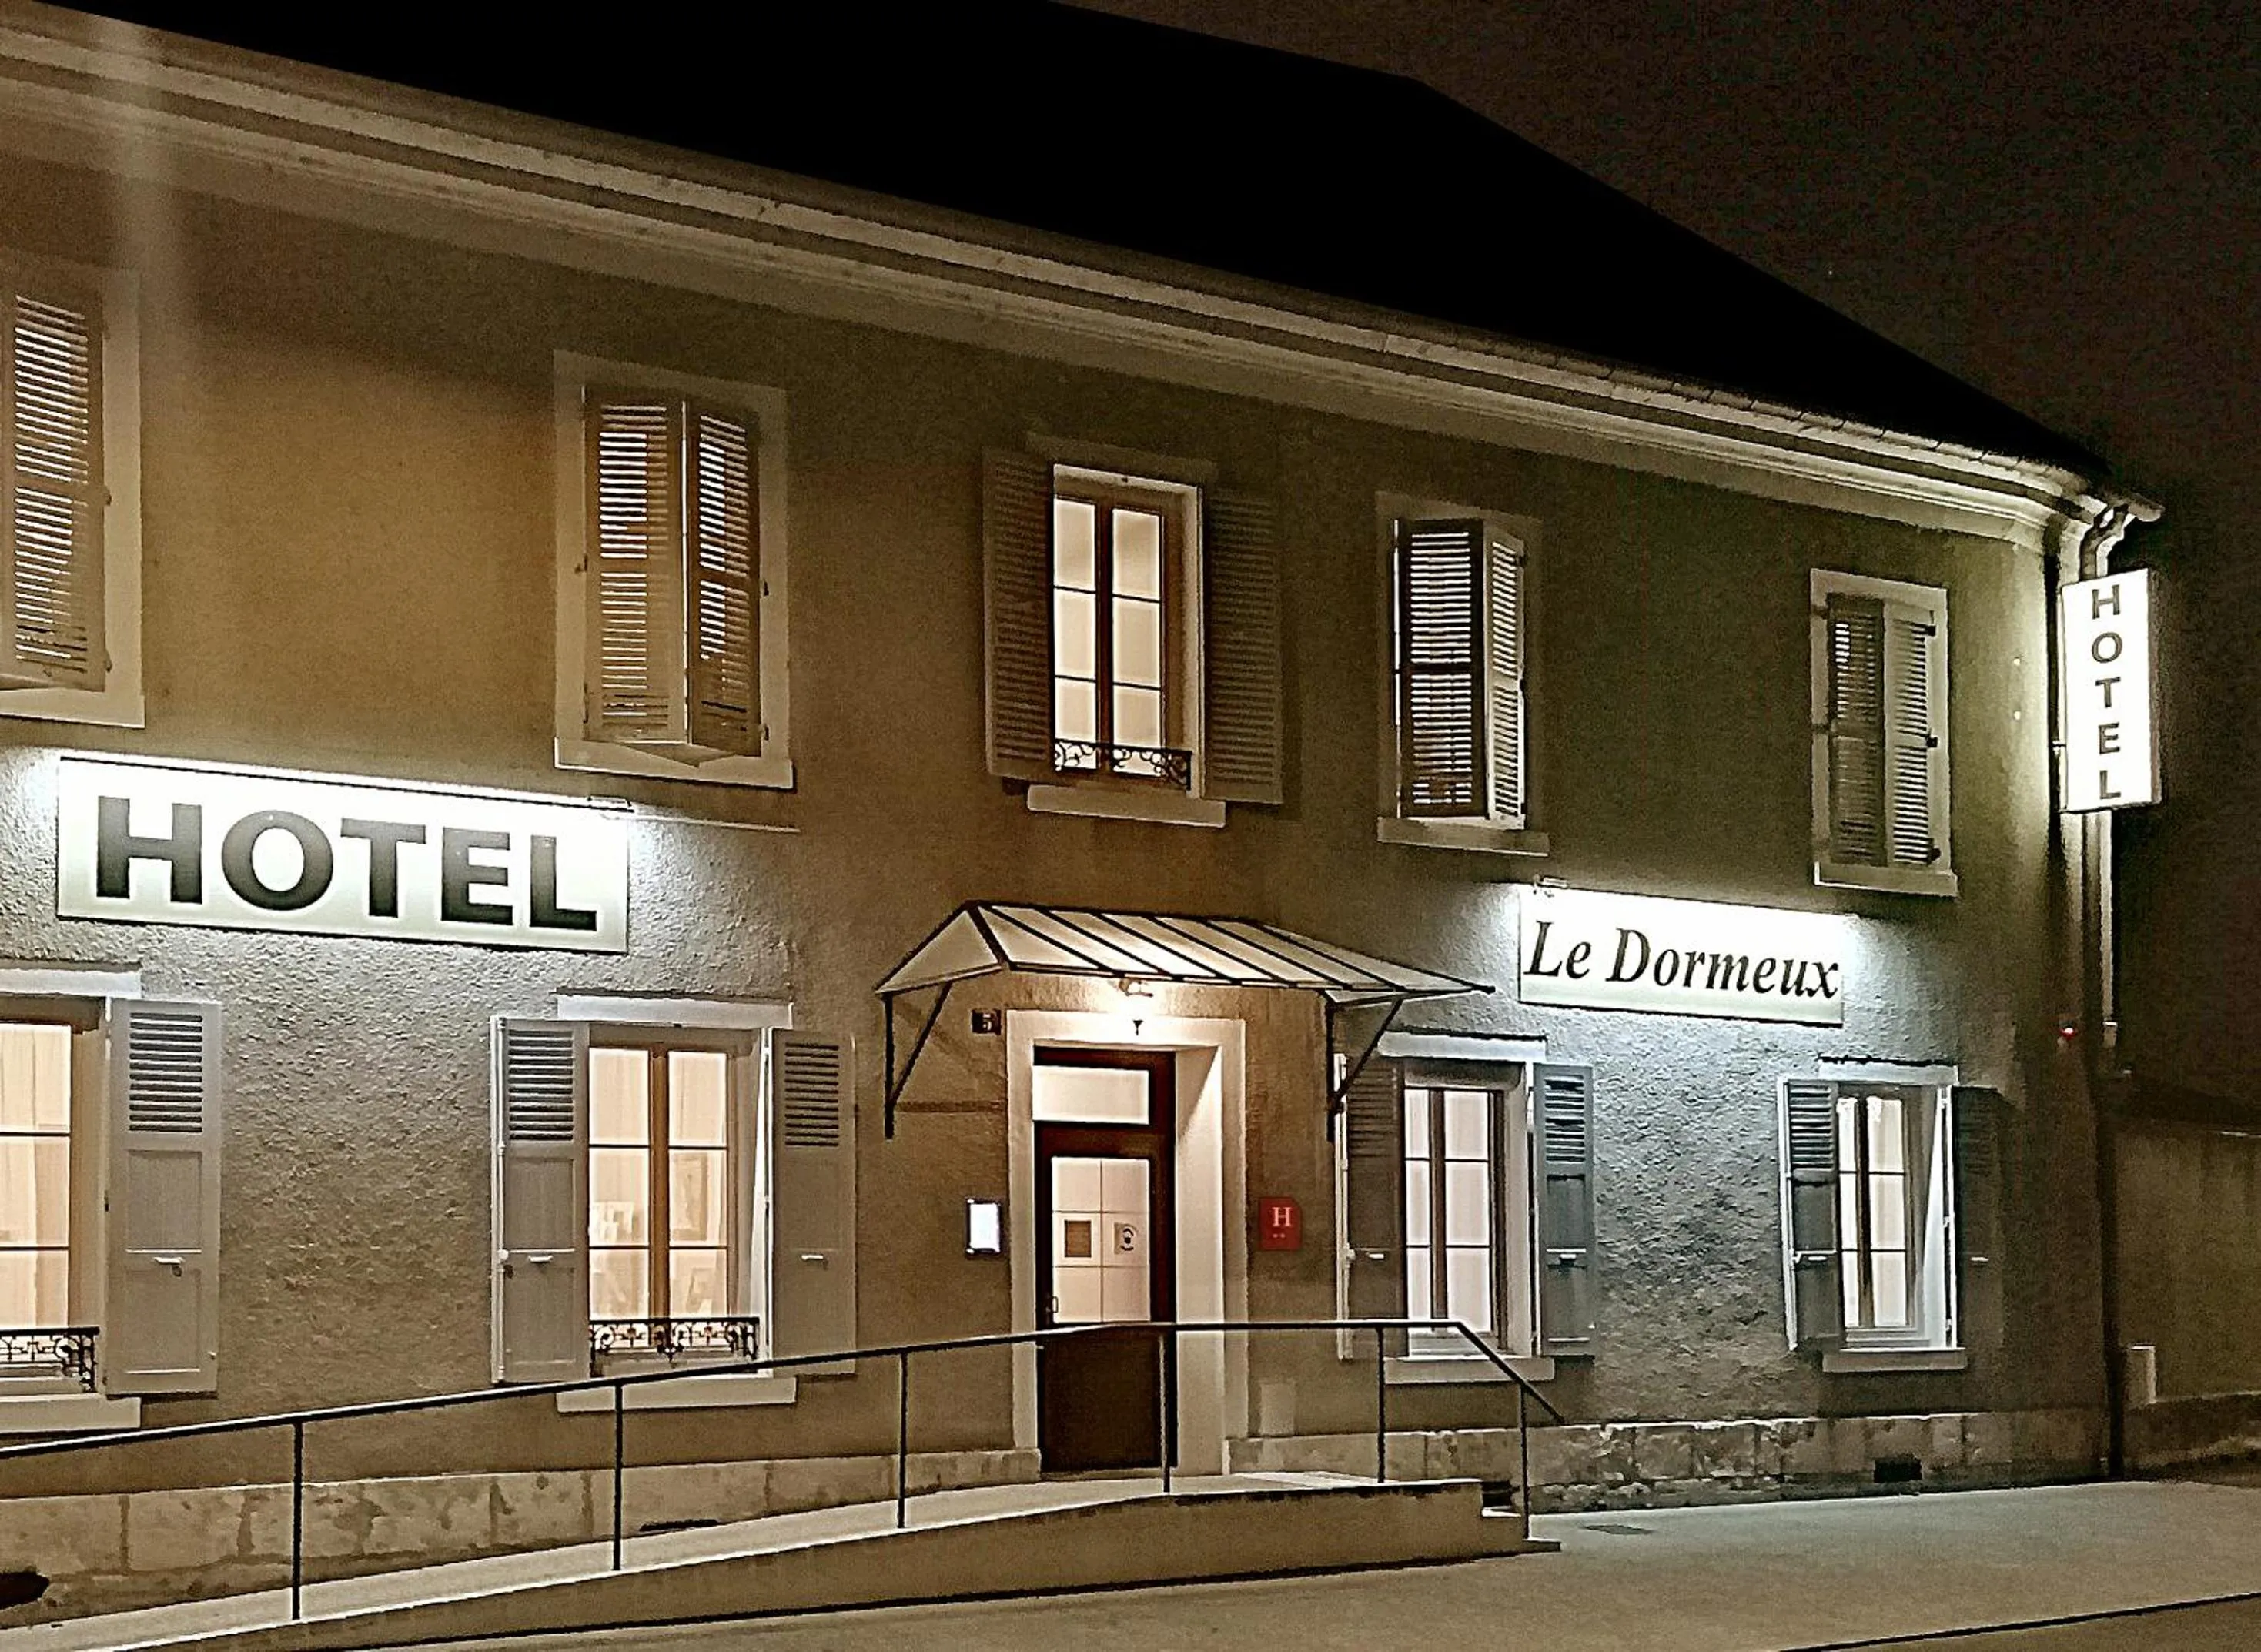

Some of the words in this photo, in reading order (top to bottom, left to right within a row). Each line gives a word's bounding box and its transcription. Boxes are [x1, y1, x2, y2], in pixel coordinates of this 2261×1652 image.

[2091, 584, 2122, 800] HOTEL
[96, 795, 597, 931] HOTEL
[1523, 921, 1592, 979] Le
[1605, 928, 1839, 998] Dormeux
[1272, 1206, 1292, 1227] H
